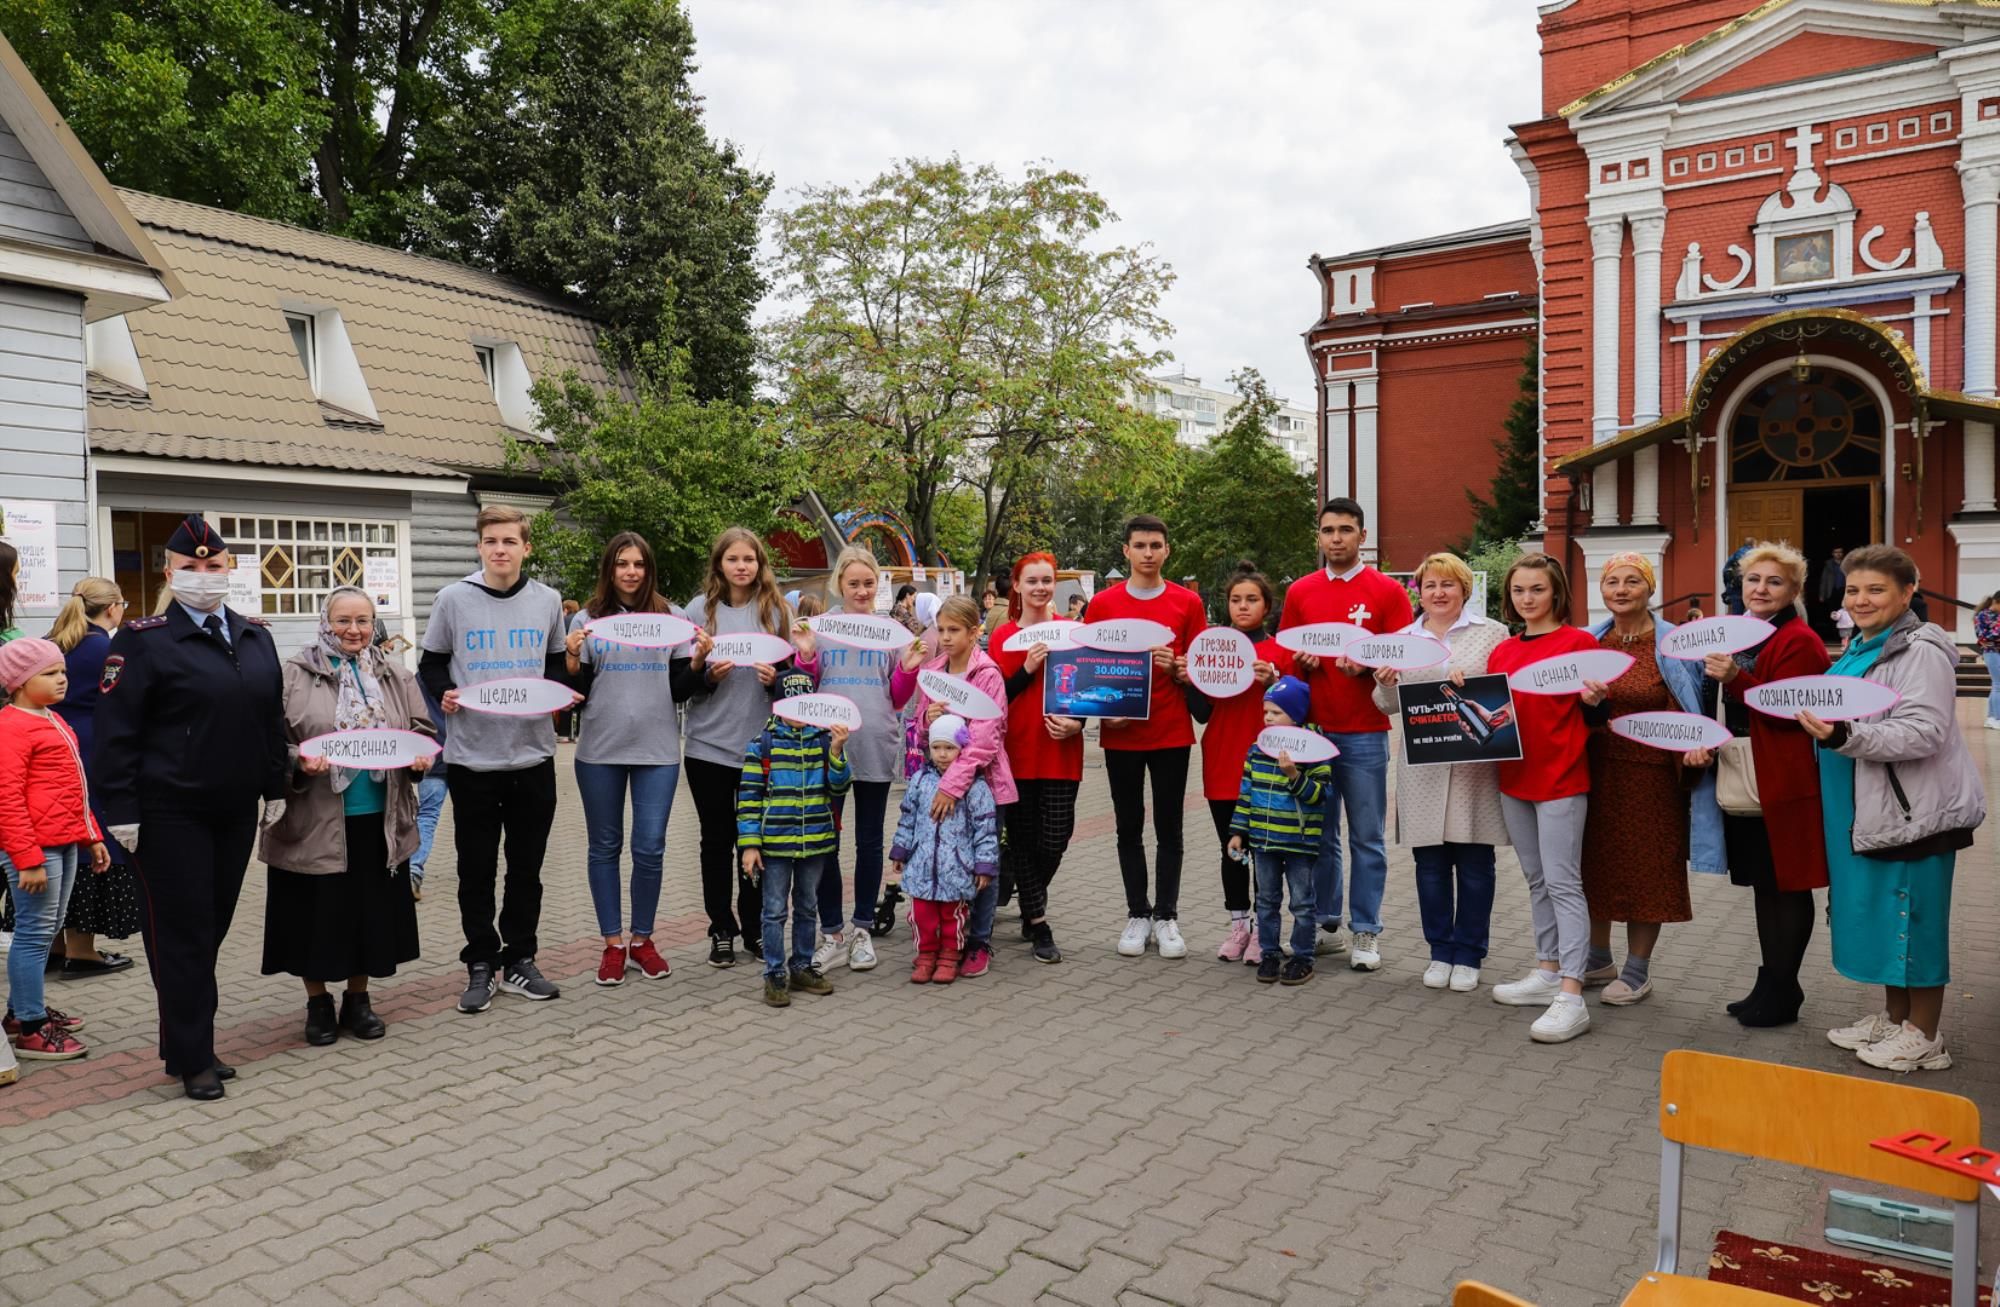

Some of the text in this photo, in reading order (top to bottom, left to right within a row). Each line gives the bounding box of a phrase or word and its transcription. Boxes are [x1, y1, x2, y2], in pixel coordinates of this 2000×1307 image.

[613, 622, 661, 638] ЧУДЕСНАЯ
[817, 618, 891, 641] ДОБРОЖЕЛАТЕЛЬНАЯ
[1019, 629, 1061, 644] РАЗУМНАЯ
[1096, 629, 1128, 643] ЯСНАЯ
[509, 629, 545, 649] ГГТУ
[1200, 638, 1237, 652] ТРЕЗВАЯ
[1302, 633, 1341, 647] КРАСИВАЯ
[1670, 626, 1726, 652] ЖЕЛАННАЯ
[1361, 644, 1404, 659] ЗДОРОВАЯ
[1194, 654, 1245, 669] ЖИЗНЬ
[1094, 665, 1129, 676] 30.000
[1198, 670, 1238, 684] ЧЕЛОВЕКА
[1532, 664, 1580, 688] ЦЕННАЯ
[480, 688, 527, 705] ЩЕДРАЯ
[1759, 688, 1843, 706] СОЗНАТЕЛЬНАЯ
[798, 702, 851, 720] ПРЕСТИЖНАЯ
[1408, 702, 1457, 715] ЧУТЬ-ЧУТЬ
[1628, 720, 1703, 742] ТРУДОСПОСОБНАЯ
